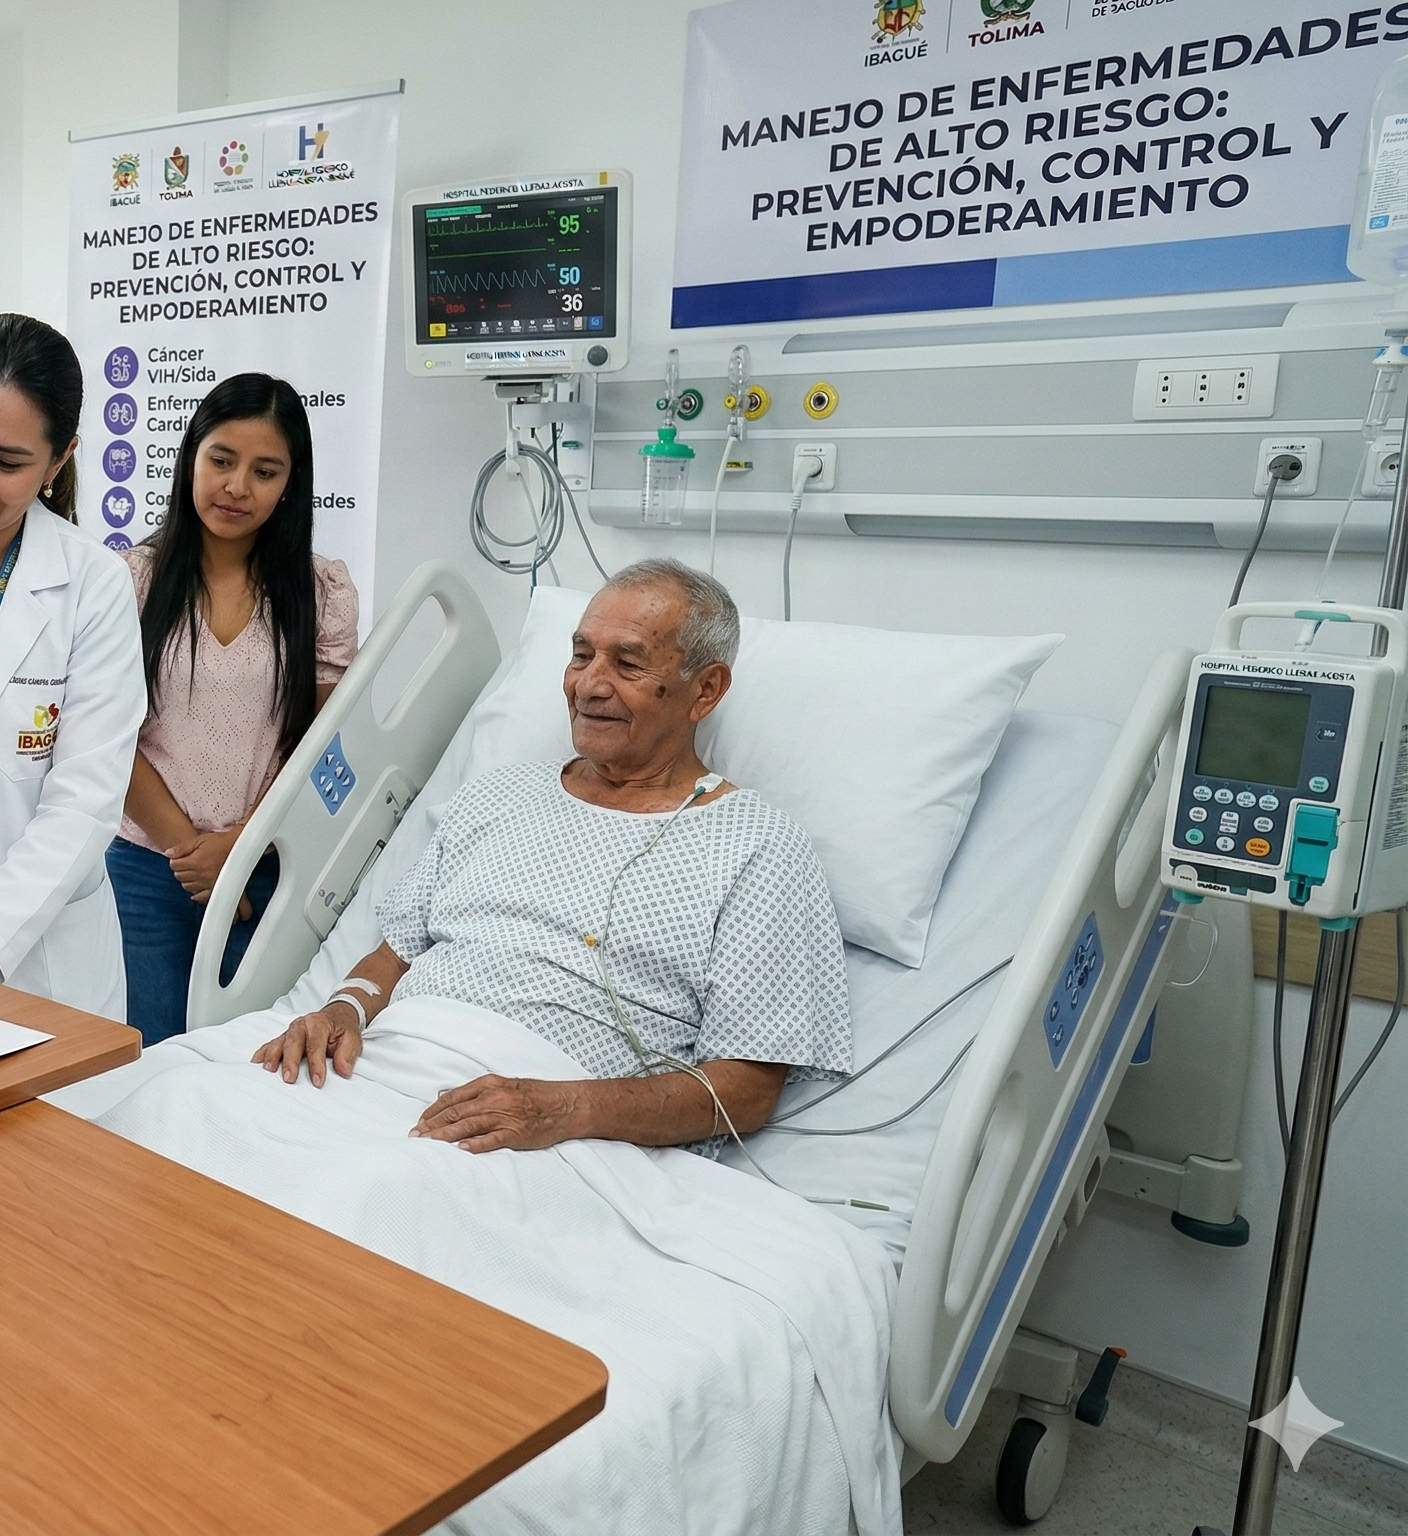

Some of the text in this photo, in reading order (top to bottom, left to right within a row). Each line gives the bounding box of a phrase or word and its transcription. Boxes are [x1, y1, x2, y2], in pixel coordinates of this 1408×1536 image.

[968, 21, 1045, 48] TOLIMA
[722, 2, 1408, 152] MANEJO DE ENFERMEDADES
[829, 86, 1229, 173] DE ALTO RIESGO:
[751, 155, 1026, 221] PREVENCIÓN,
[1041, 122, 1292, 185] CONTROL
[1309, 112, 1350, 150] Y
[83, 201, 378, 249] MANEJO DE ENFERMEDADES
[559, 214, 580, 235] 95
[805, 174, 1250, 252] EMPODERAMIENTO
[133, 237, 314, 270] DE ALTO RIESGO:
[90, 261, 367, 299] PREVENCIÓN, CONTROL Y
[119, 292, 327, 323] EMPODERAMIENTO
[561, 293, 583, 312] 36
[148, 347, 204, 363] Cáncer
[147, 366, 216, 384] VIH/Sida
[148, 390, 346, 410] Enferm nales
[147, 416, 188, 432] Cardi
[146, 464, 172, 478] Eve
[313, 492, 355, 509] ades
